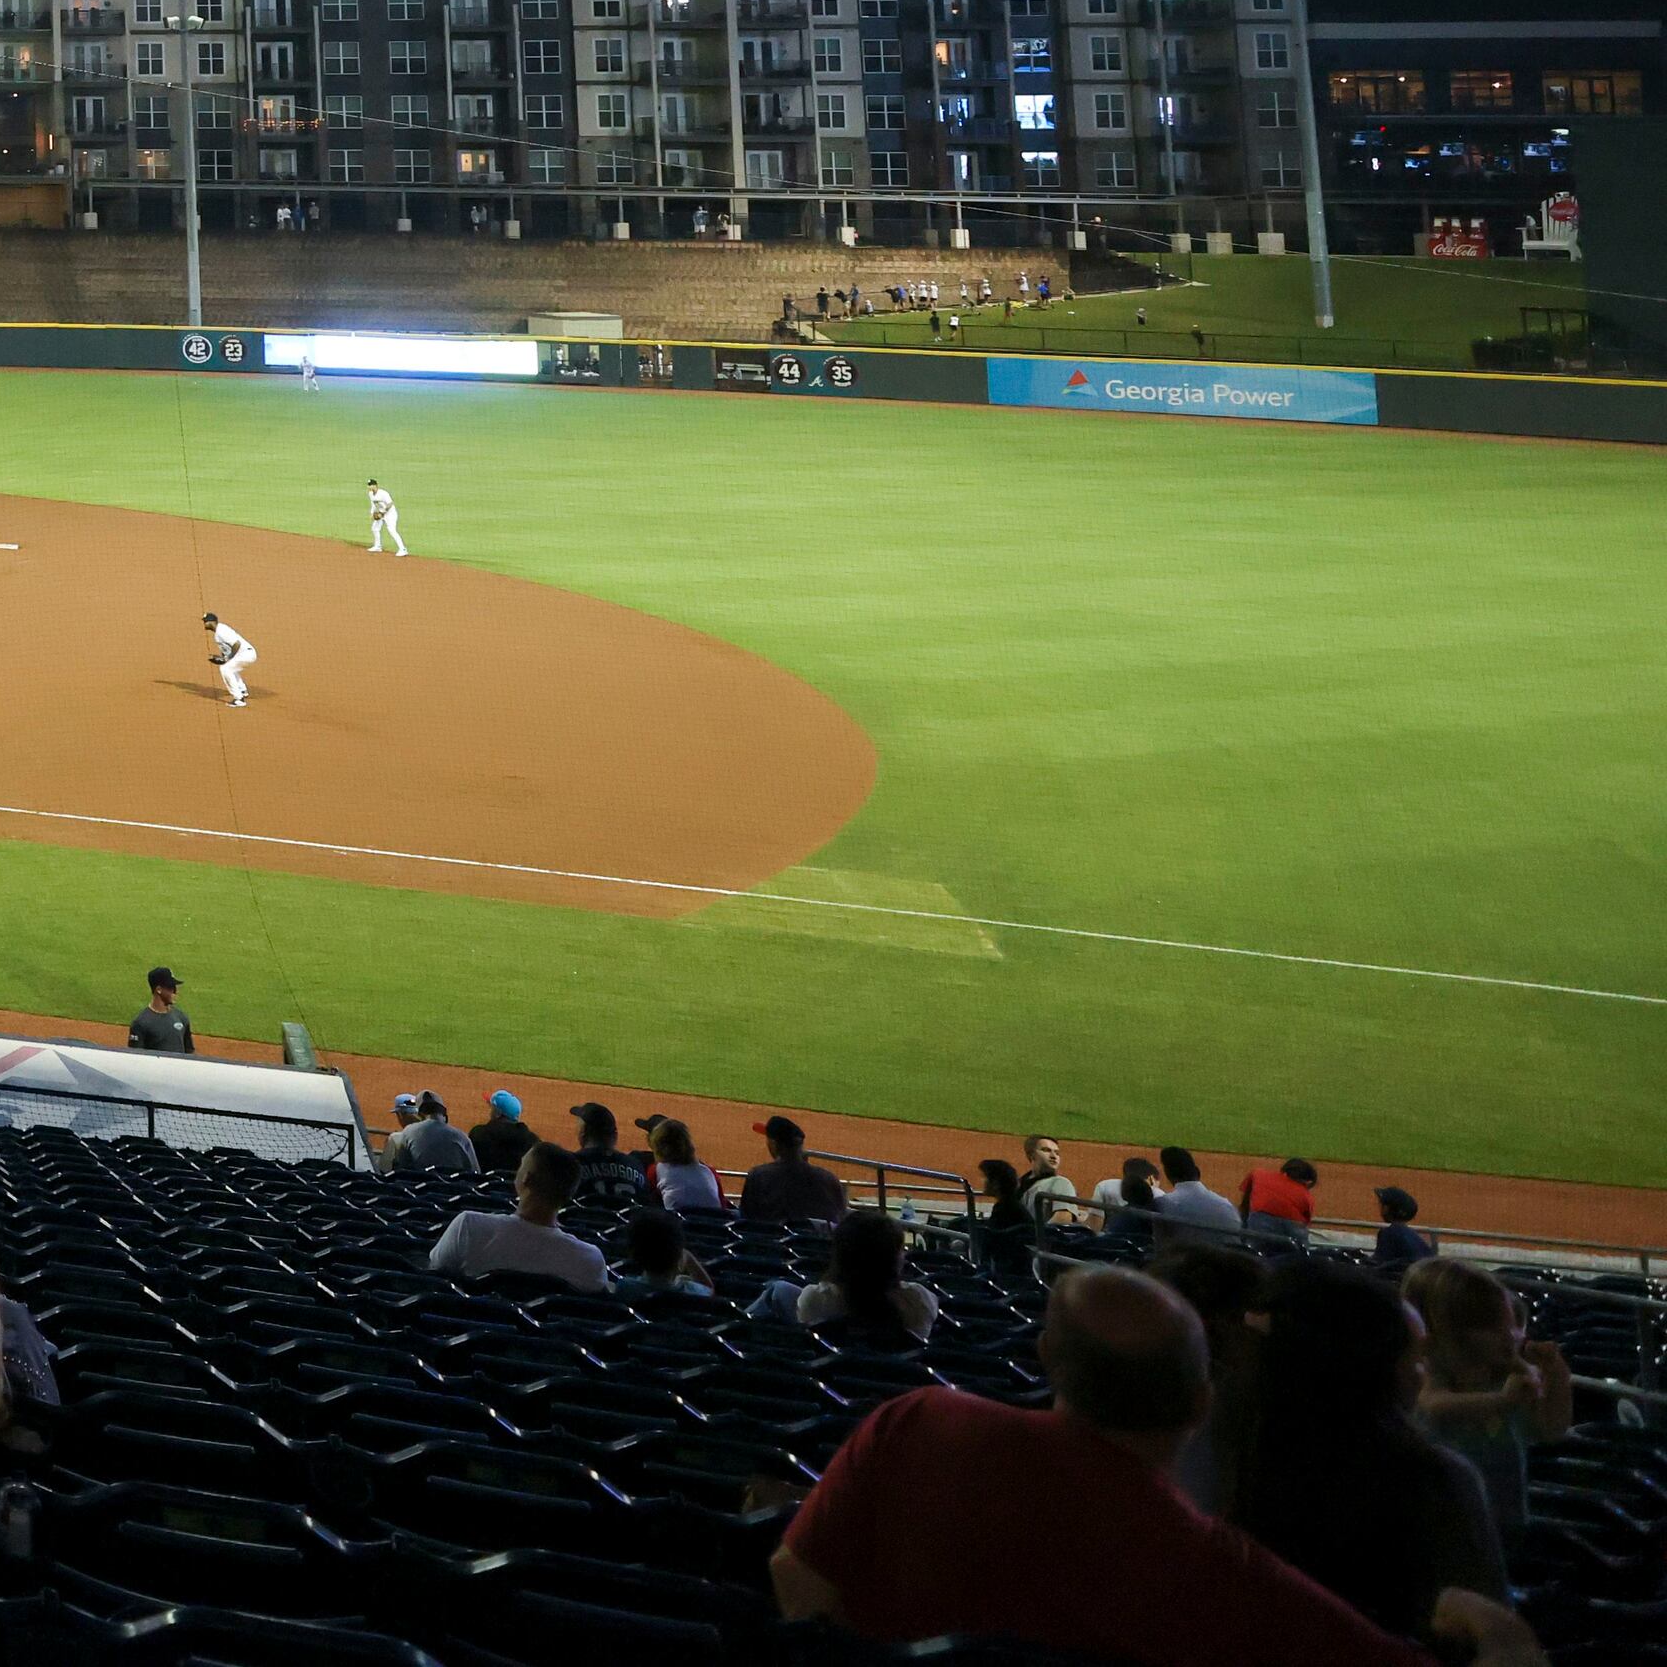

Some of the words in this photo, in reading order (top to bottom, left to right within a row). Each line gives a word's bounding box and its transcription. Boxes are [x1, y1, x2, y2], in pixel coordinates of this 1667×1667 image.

[189, 342, 206, 356] 42
[225, 343, 243, 357] 23
[778, 363, 801, 378] 44
[831, 365, 852, 381] 35
[1105, 380, 1205, 406] Georgia
[1213, 384, 1295, 407] Power
